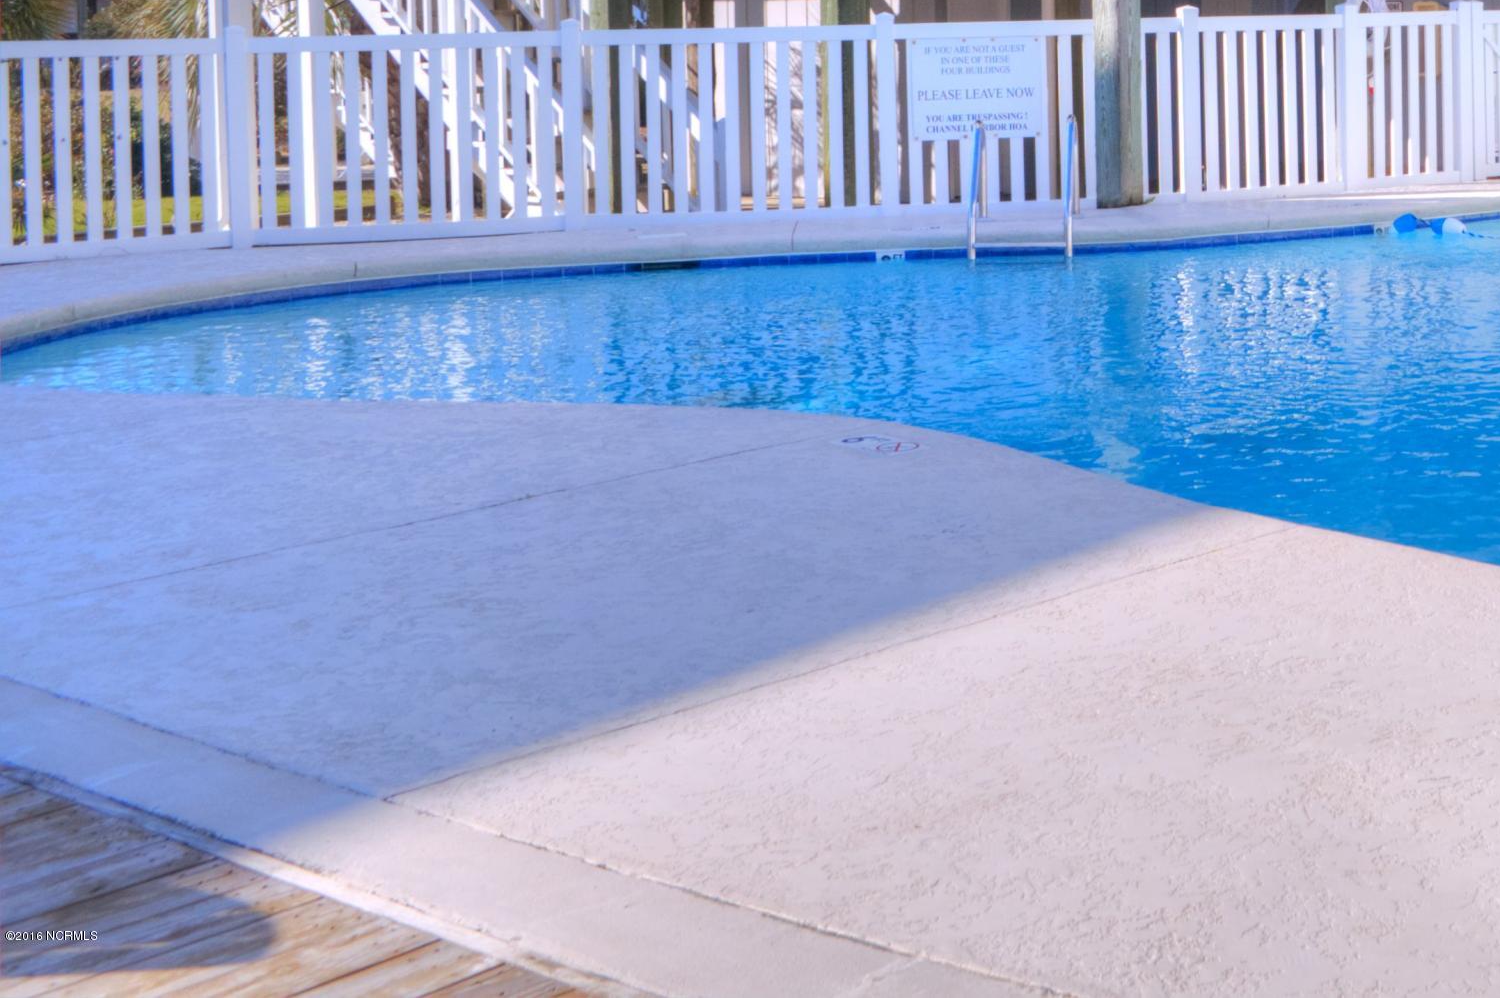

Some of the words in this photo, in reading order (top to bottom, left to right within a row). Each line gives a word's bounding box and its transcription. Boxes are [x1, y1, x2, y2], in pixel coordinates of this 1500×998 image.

[924, 46, 931, 55] IF
[933, 46, 952, 54] YOU
[955, 45, 970, 54] ARE
[972, 45, 988, 53] NOT
[991, 45, 997, 53] A
[998, 44, 1026, 53] GUEST
[941, 57, 950, 65] IN
[951, 56, 969, 64] ONE
[971, 56, 981, 64] OF
[984, 55, 1009, 64] THESE
[941, 67, 964, 75] FOUR
[966, 65, 1011, 75] BUILDINGS
[917, 89, 962, 101] PLEASE
[965, 88, 1003, 100] LEAVE
[1006, 86, 1035, 98] NOW
[926, 114, 944, 123] YOU
[947, 114, 964, 122] ARE
[967, 112, 1024, 122] TRESPASSING
[926, 124, 969, 134] CHANNEL
[1009, 122, 1028, 131] HOA
